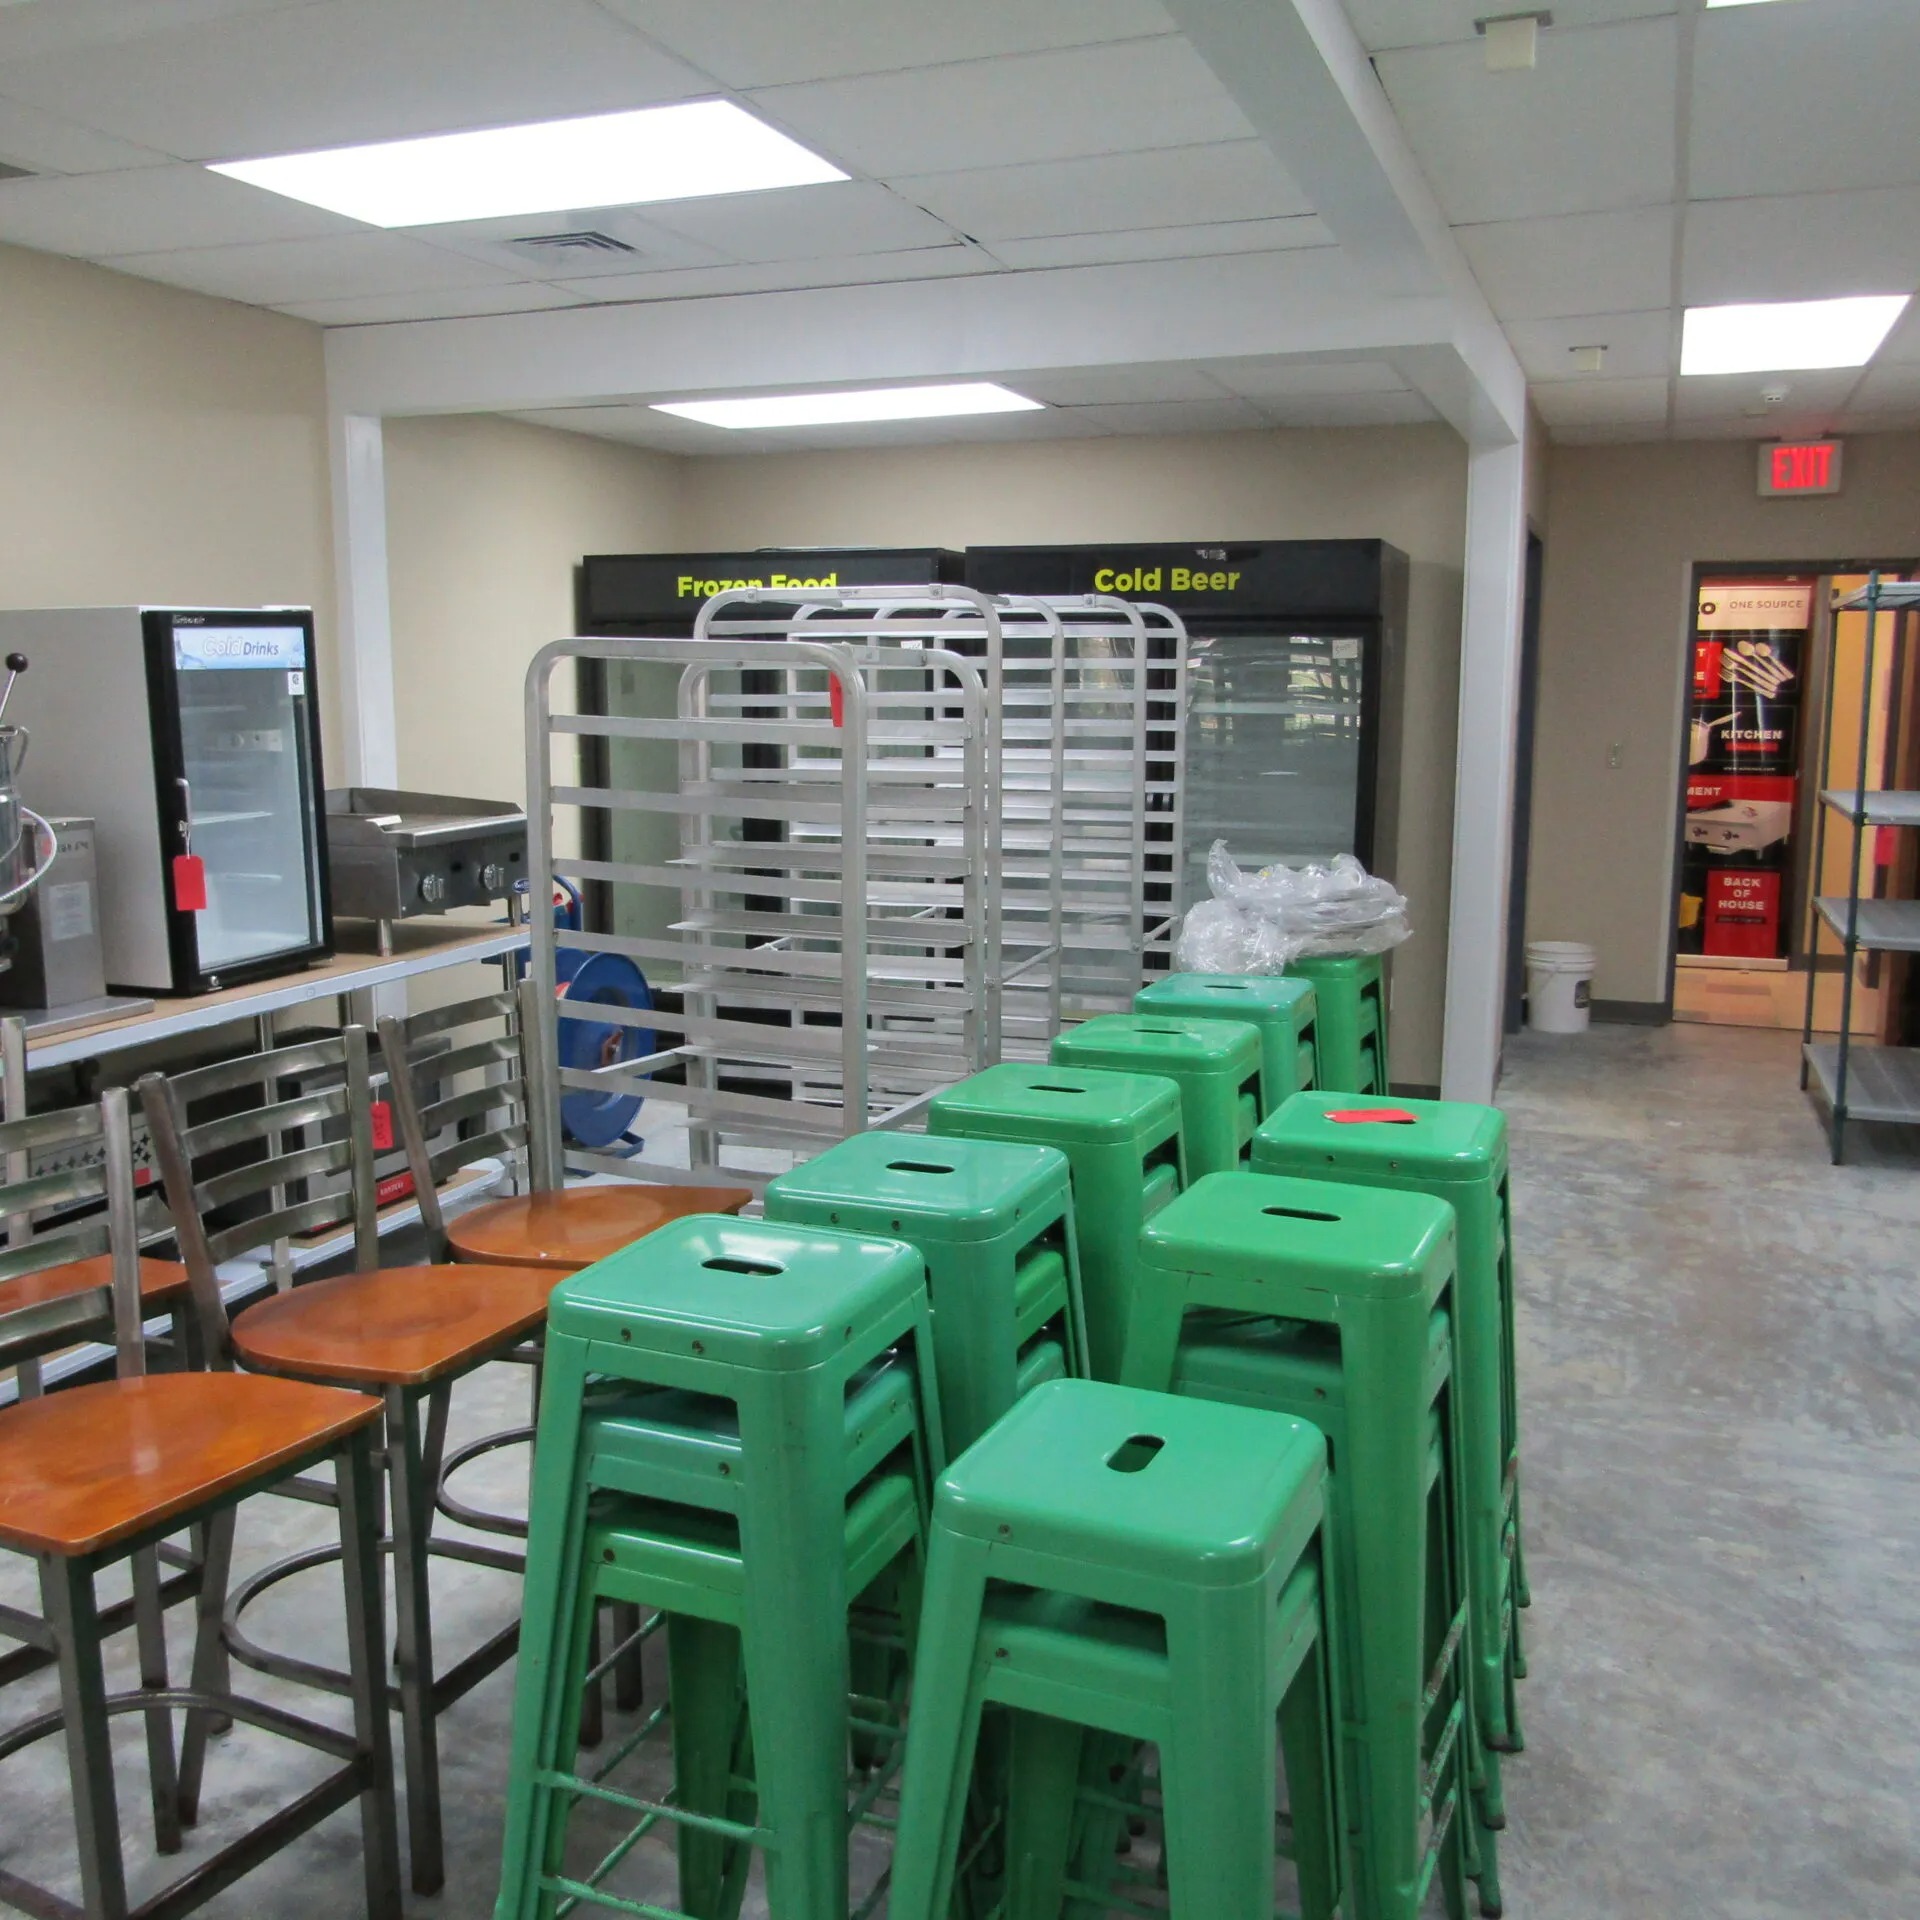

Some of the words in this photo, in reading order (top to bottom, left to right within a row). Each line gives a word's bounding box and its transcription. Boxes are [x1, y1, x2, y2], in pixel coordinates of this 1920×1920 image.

[1772, 446, 1834, 489] EXIT
[771, 573, 837, 589] Food
[1094, 568, 1162, 592] Cold
[1171, 568, 1241, 591] Beer
[1729, 600, 1753, 609] ONE
[1756, 600, 1804, 609] SOURCE
[203, 636, 244, 656] Cold
[243, 641, 279, 656] Drinks
[1721, 729, 1783, 740] KITCHEN
[1723, 877, 1761, 887] BACK
[1733, 889, 1751, 898] OF
[1718, 900, 1765, 911] HOUSE
